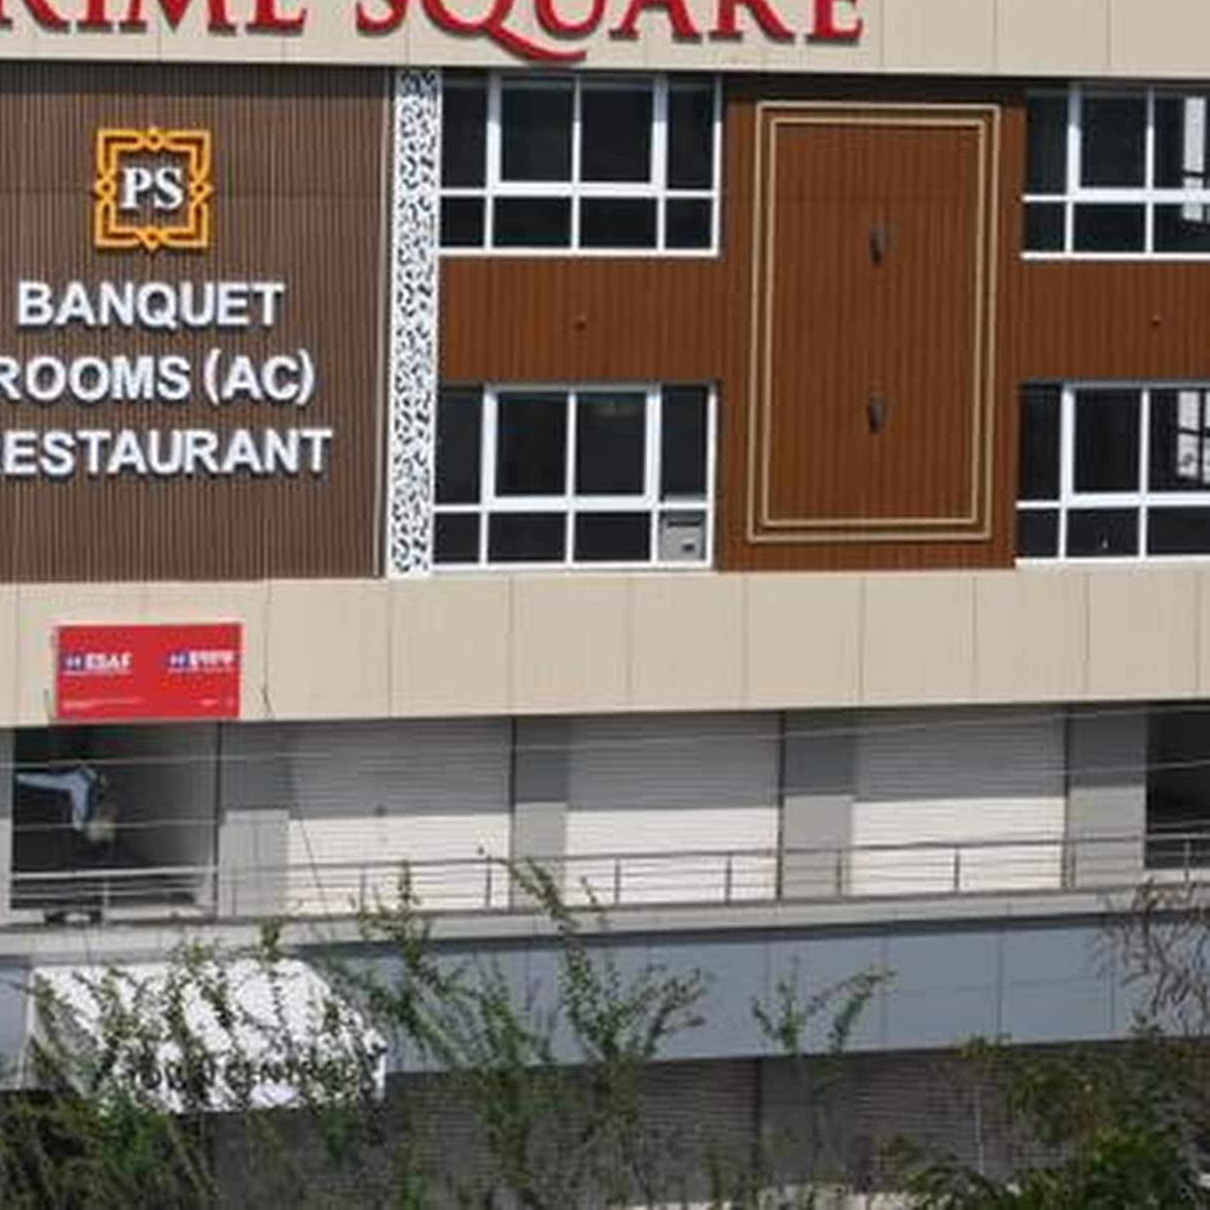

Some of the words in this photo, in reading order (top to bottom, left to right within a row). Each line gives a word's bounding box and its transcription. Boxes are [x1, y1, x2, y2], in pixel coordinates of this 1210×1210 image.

[121, 166, 184, 210] PS
[16, 280, 286, 330] BANQUET
[203, 348, 316, 406] (AC)
